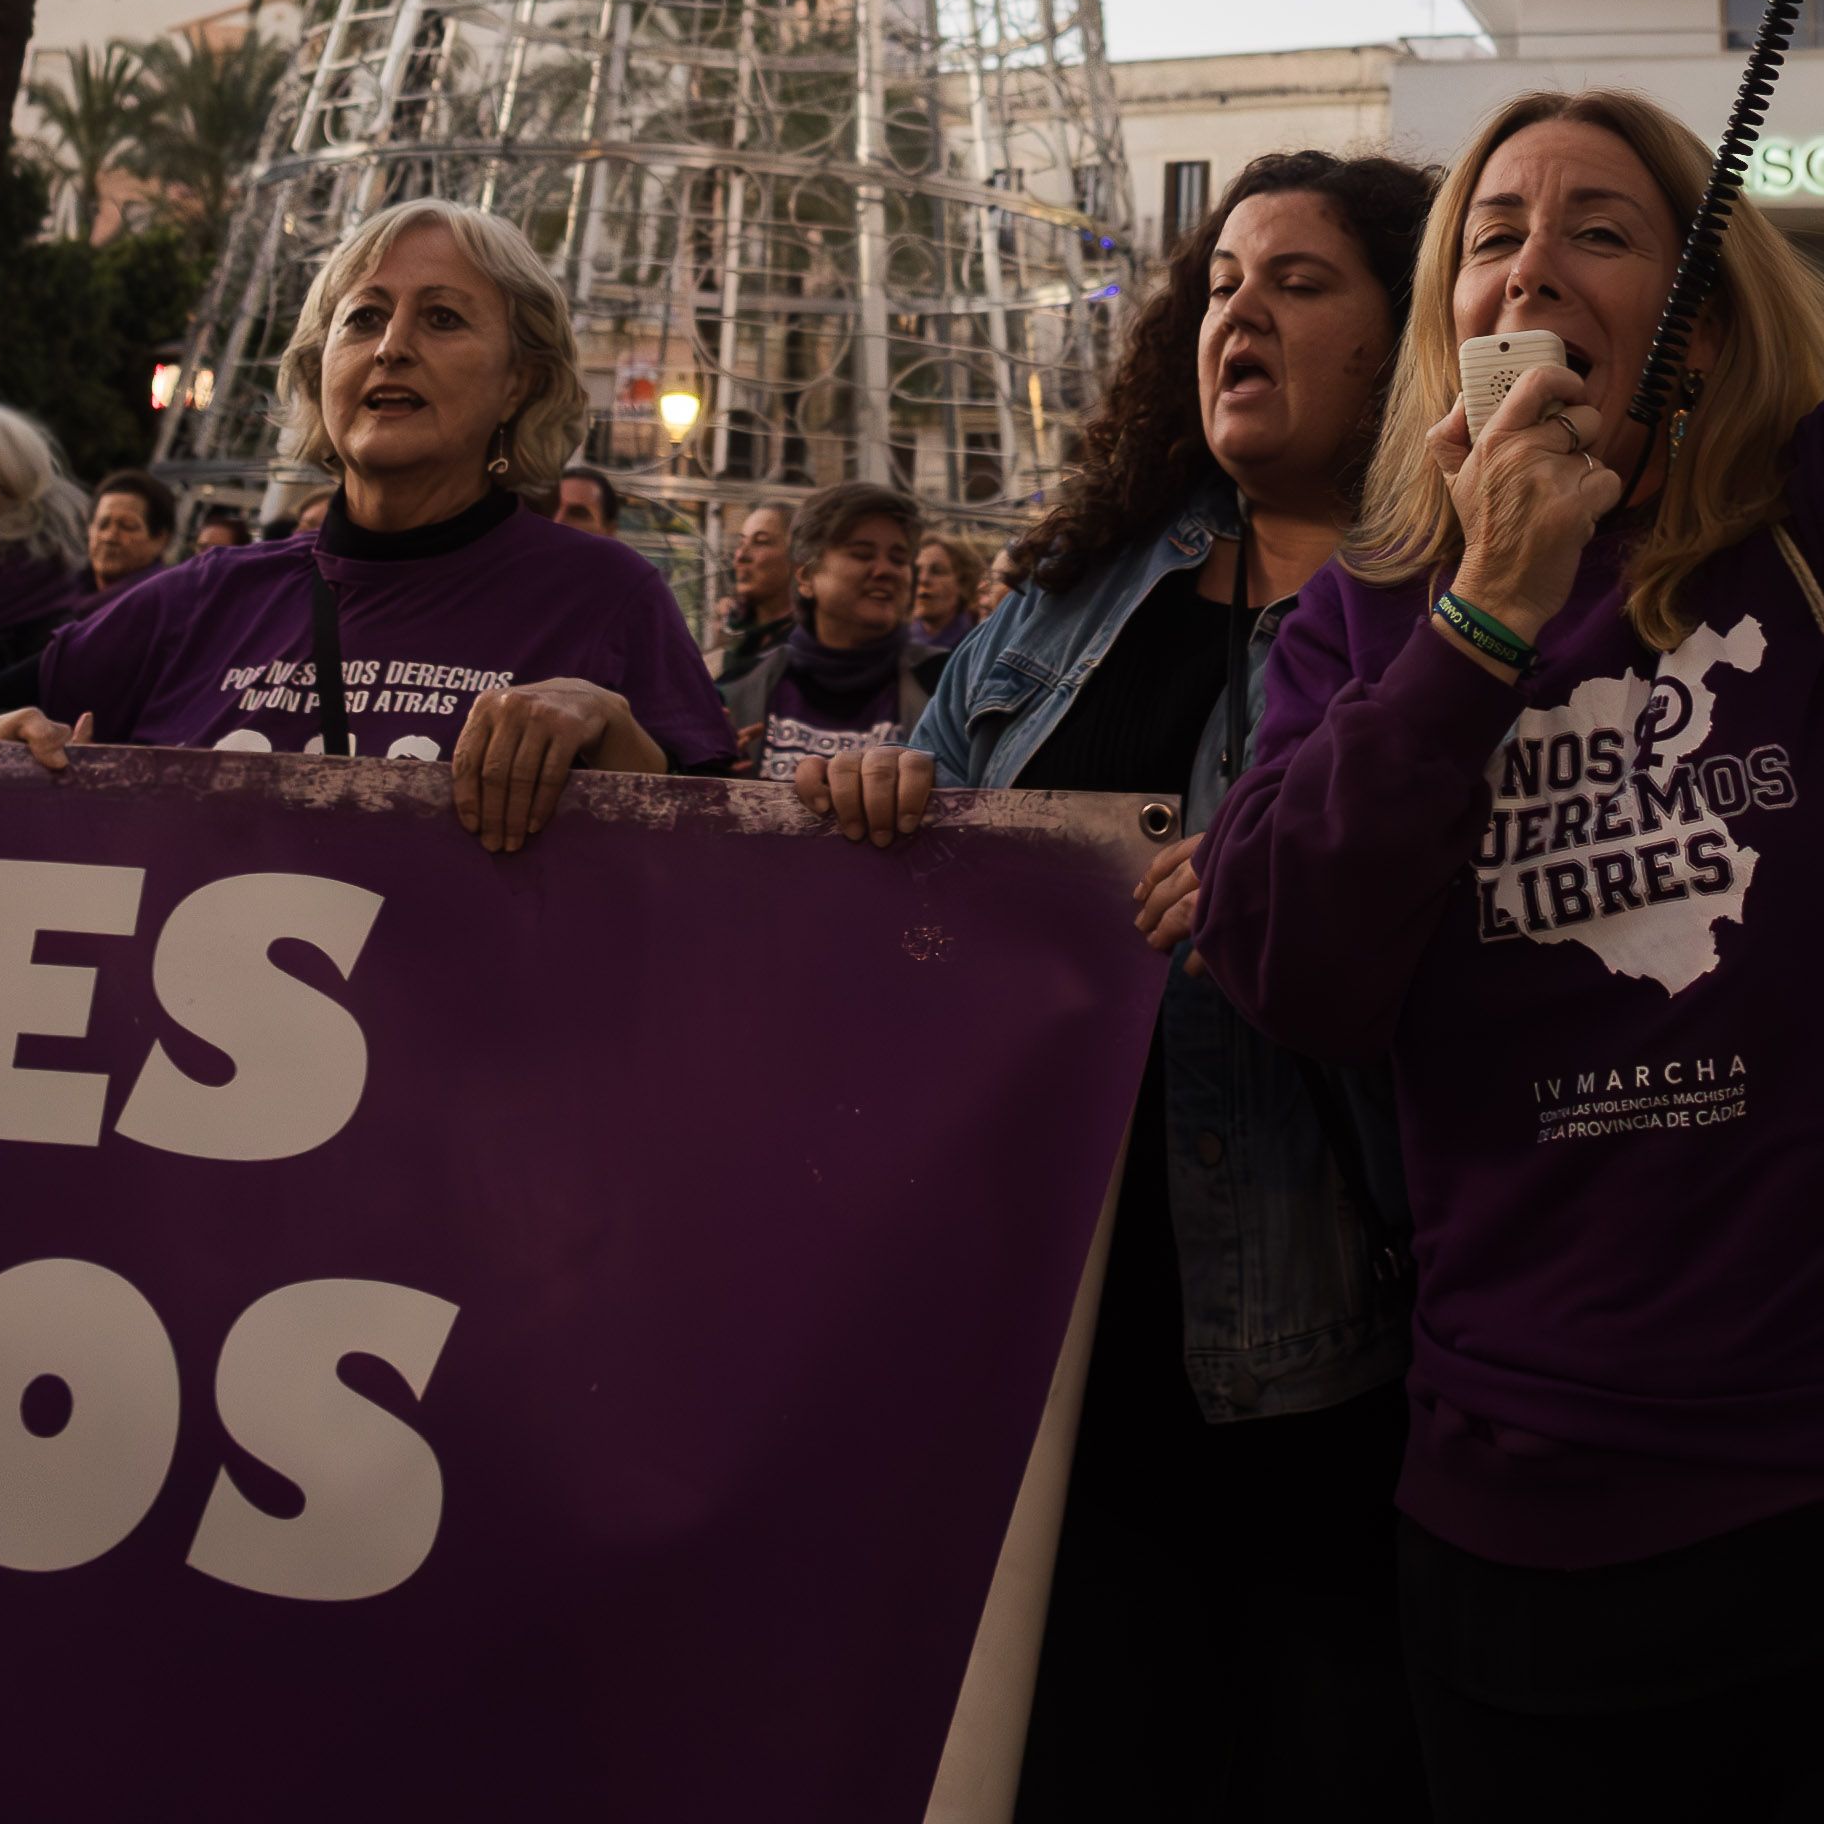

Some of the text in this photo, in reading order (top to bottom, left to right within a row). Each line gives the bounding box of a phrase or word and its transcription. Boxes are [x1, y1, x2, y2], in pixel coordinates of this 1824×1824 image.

[1461, 620, 1471, 632] Y
[384, 661, 515, 692] DERECHOS
[303, 690, 370, 713] PSO
[1497, 727, 1626, 800] NOS
[1469, 743, 1800, 868] UEREMOS
[1477, 829, 1736, 944] LIBRES
[1533, 1054, 1747, 1103] IV MARCHA
[1592, 1094, 1670, 1114] VIOLENCIAS
[1672, 1083, 1746, 1105] MACHISTAS
[1568, 1113, 1663, 1138] PROVINCIA
[1665, 1111, 1691, 1129] DE
[1695, 1100, 1747, 1127] CÁDIZ
